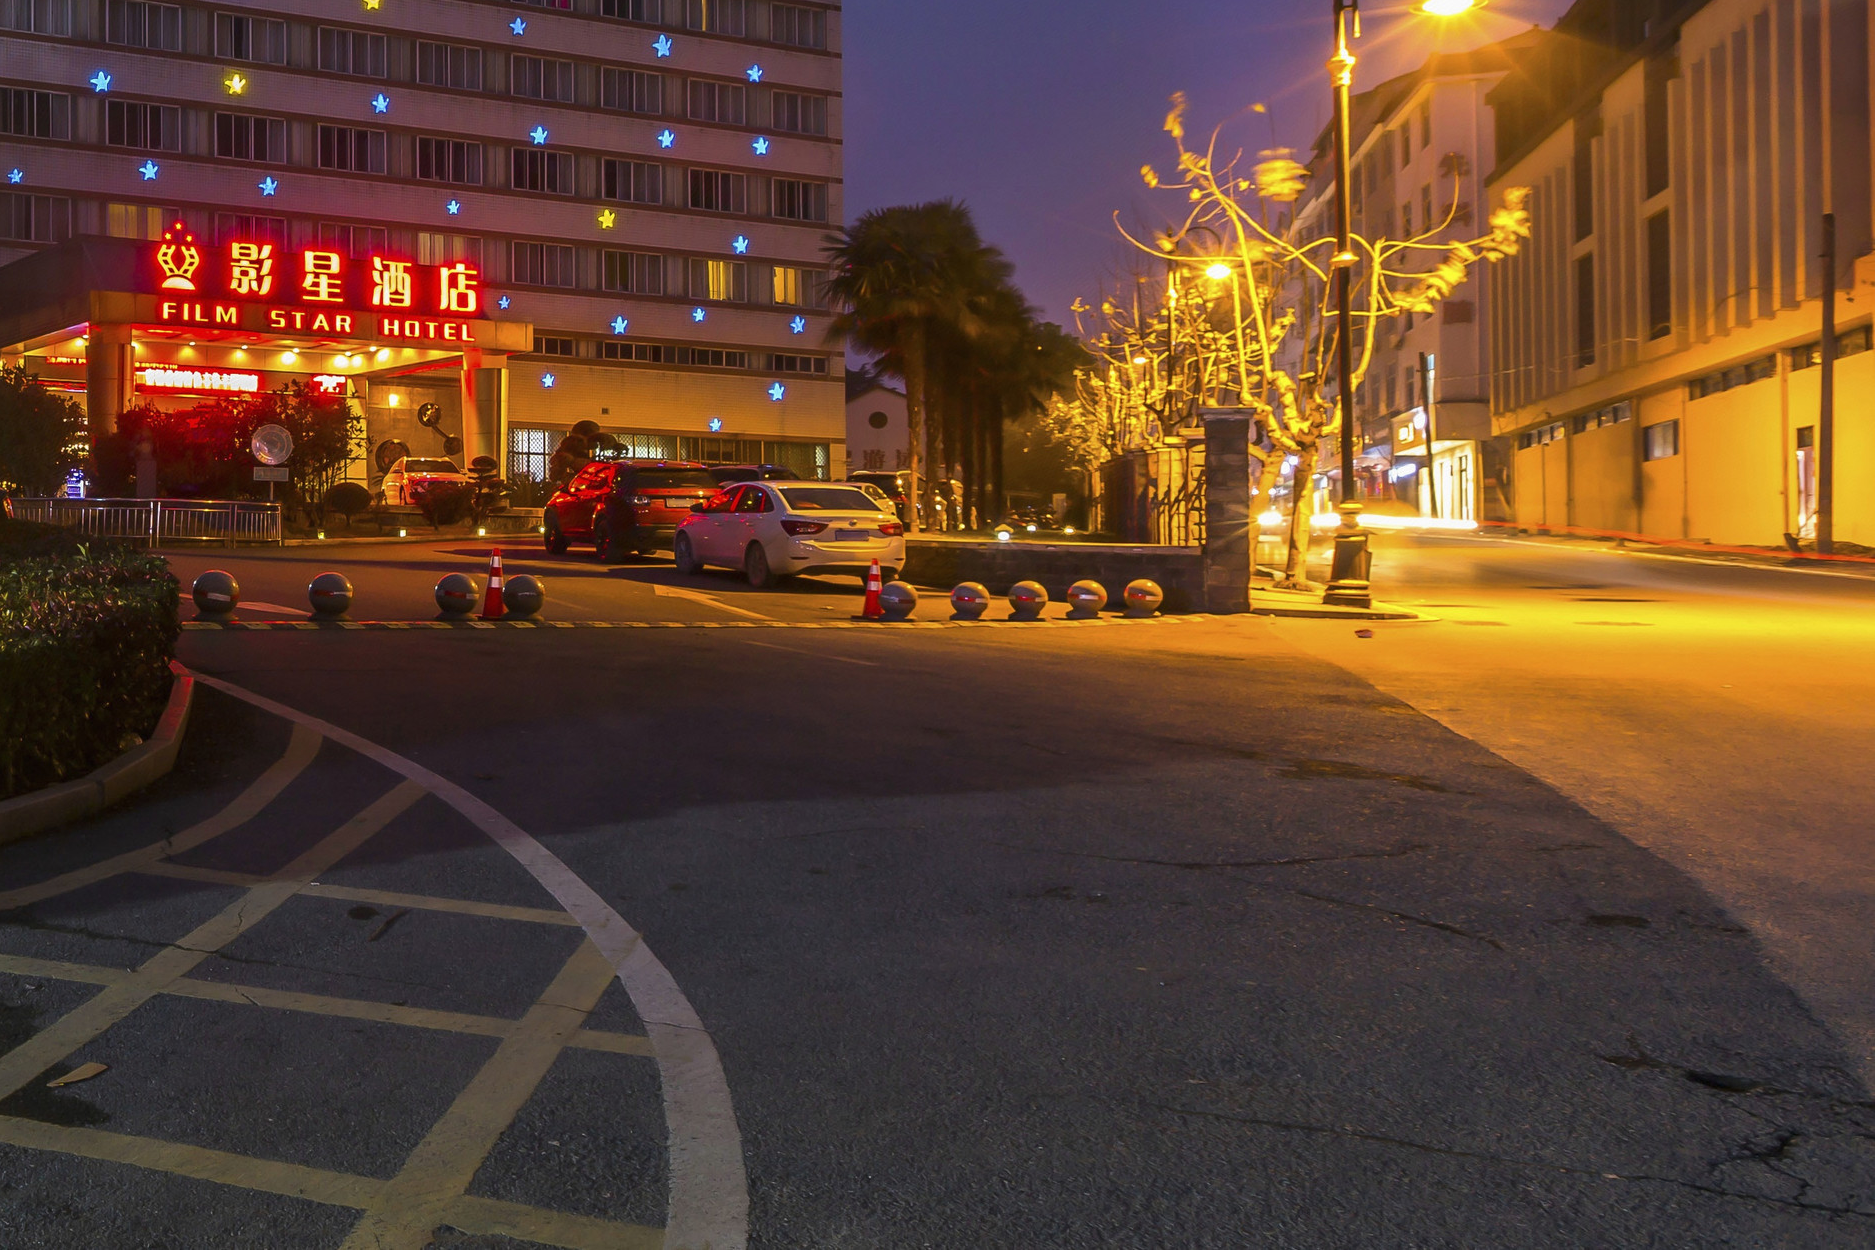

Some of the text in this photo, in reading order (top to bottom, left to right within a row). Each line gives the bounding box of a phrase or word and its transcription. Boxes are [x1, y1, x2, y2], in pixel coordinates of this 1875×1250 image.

[229, 241, 479, 314] 影星酒店
[161, 301, 476, 343] FILM STAR HOTEL
